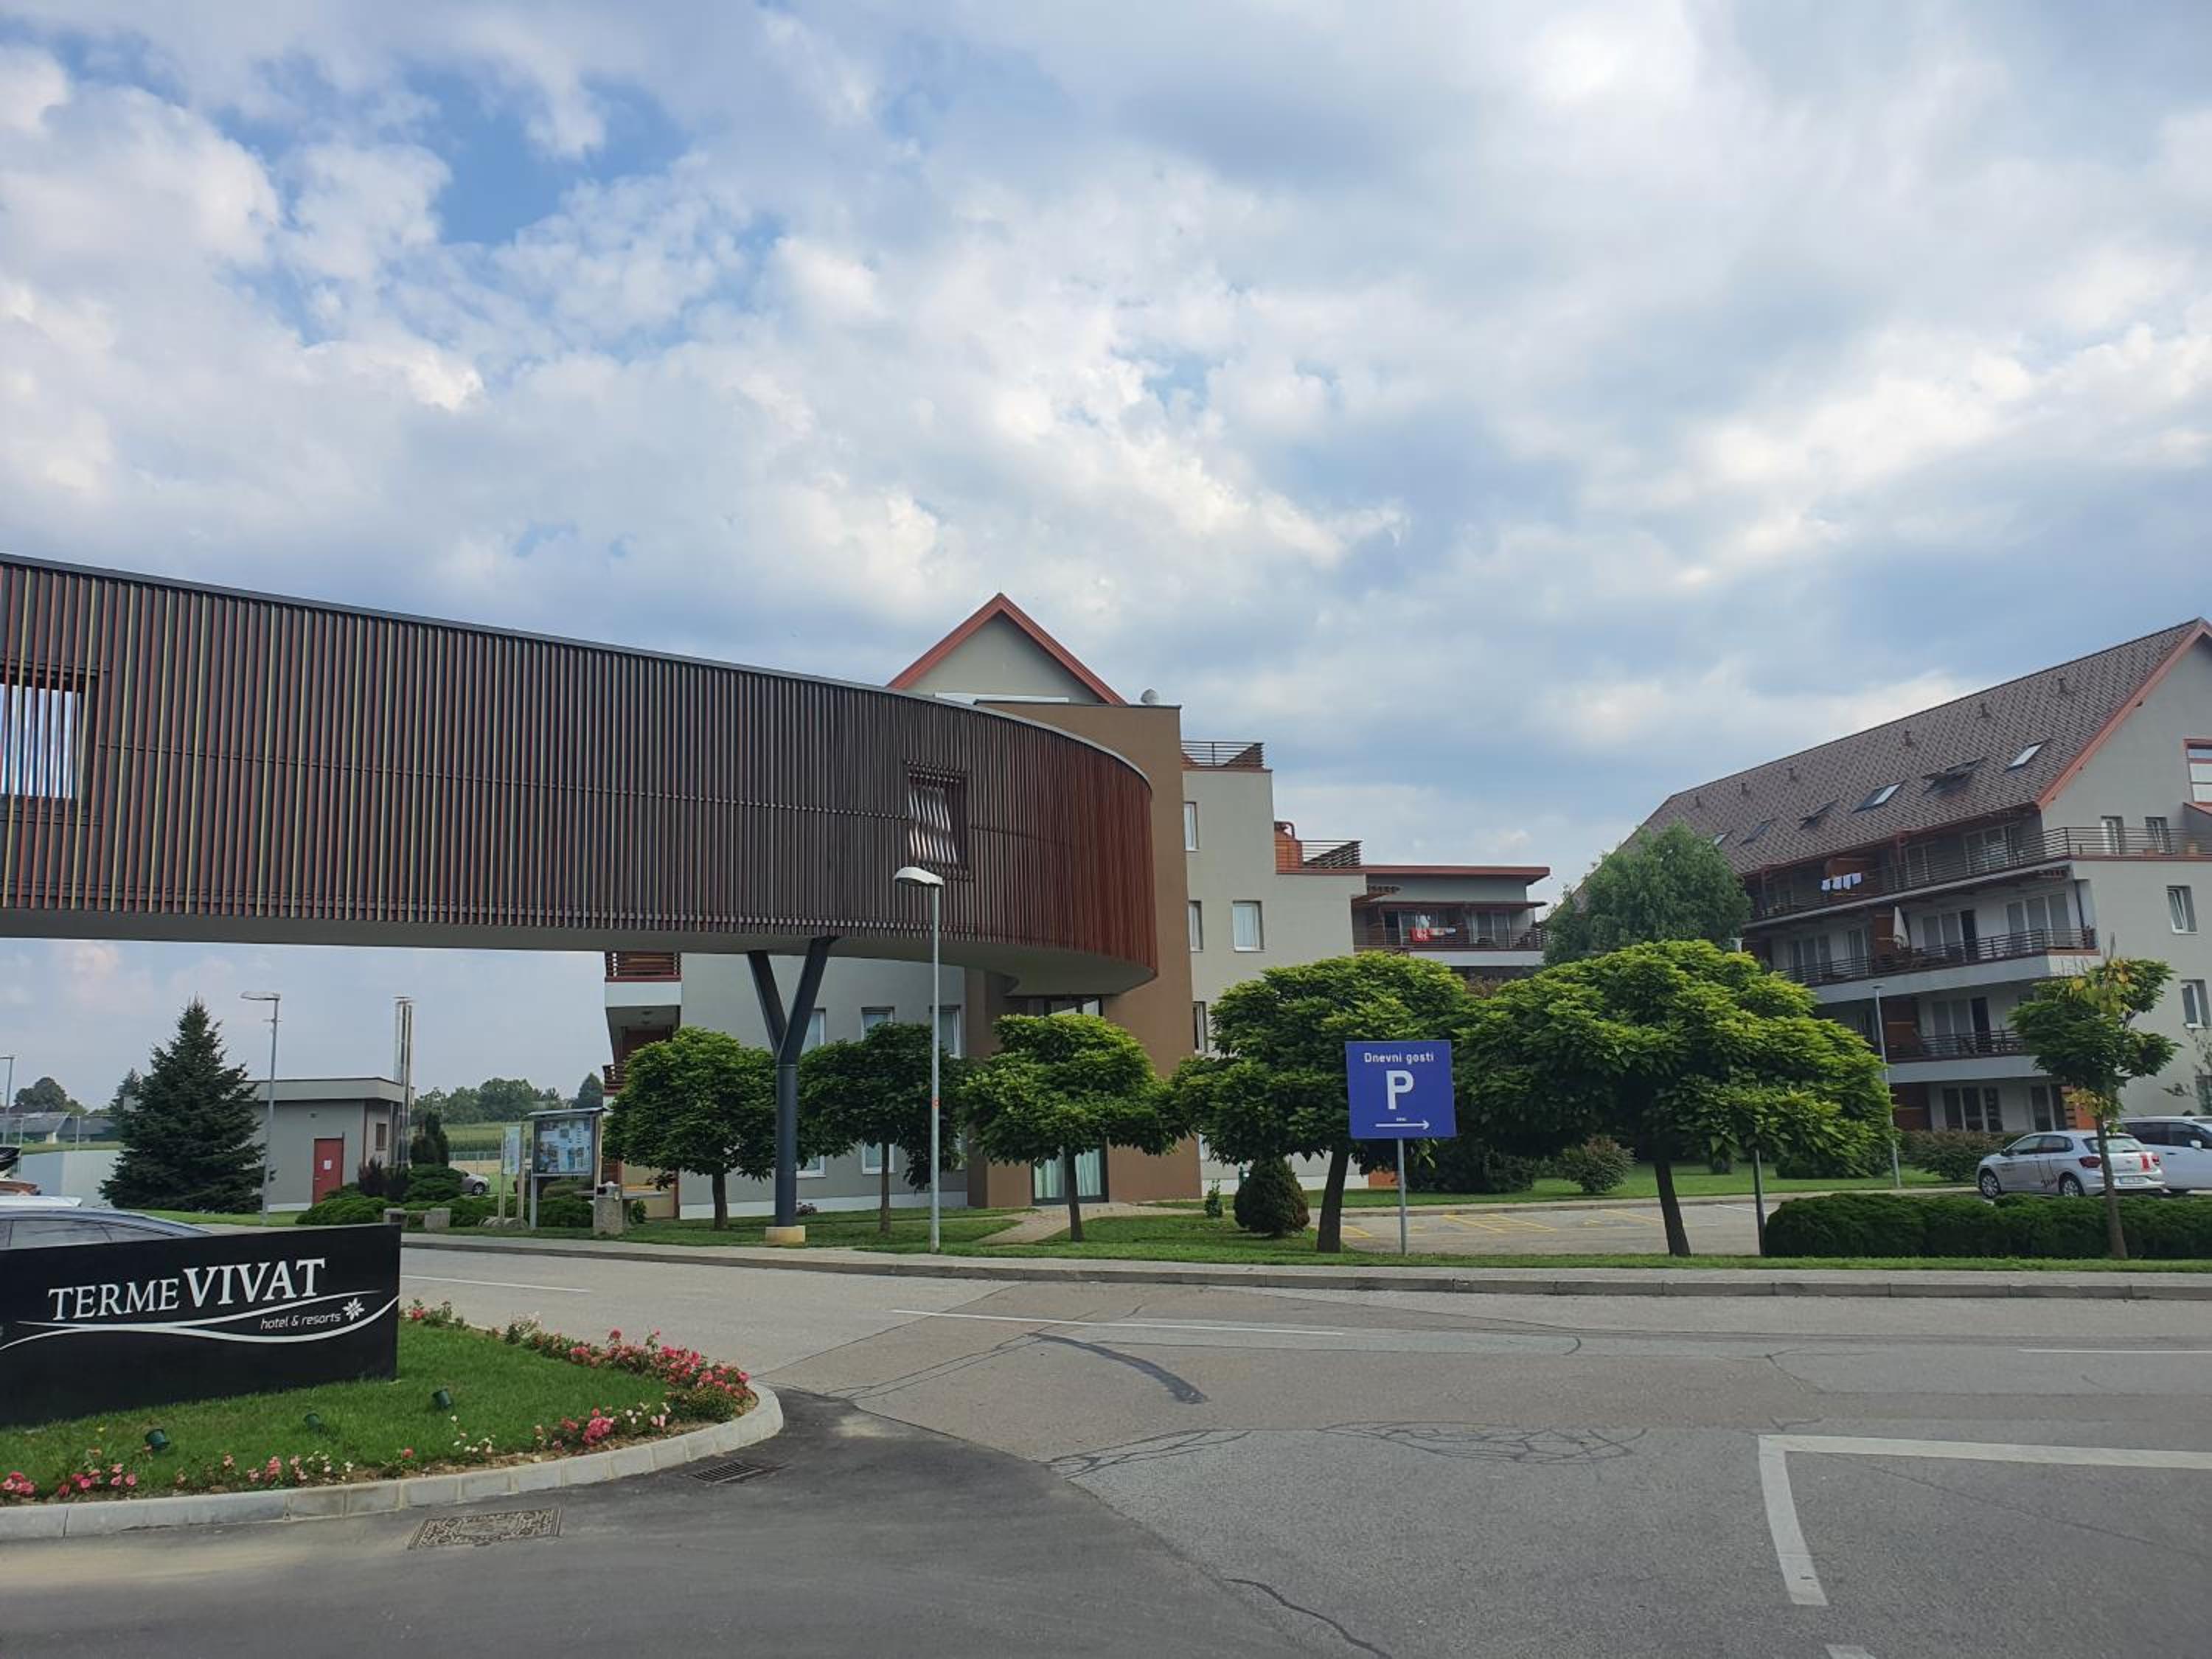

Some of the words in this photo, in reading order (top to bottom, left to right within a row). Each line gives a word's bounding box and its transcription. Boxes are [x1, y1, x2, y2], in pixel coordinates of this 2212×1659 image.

[1364, 1052, 1402, 1062] Dnevni
[1406, 1051, 1434, 1065] gosti
[1386, 1070, 1413, 1110] P
[260, 1316, 289, 1330] hotel
[291, 1315, 299, 1326] &
[302, 1313, 341, 1326] resorts
